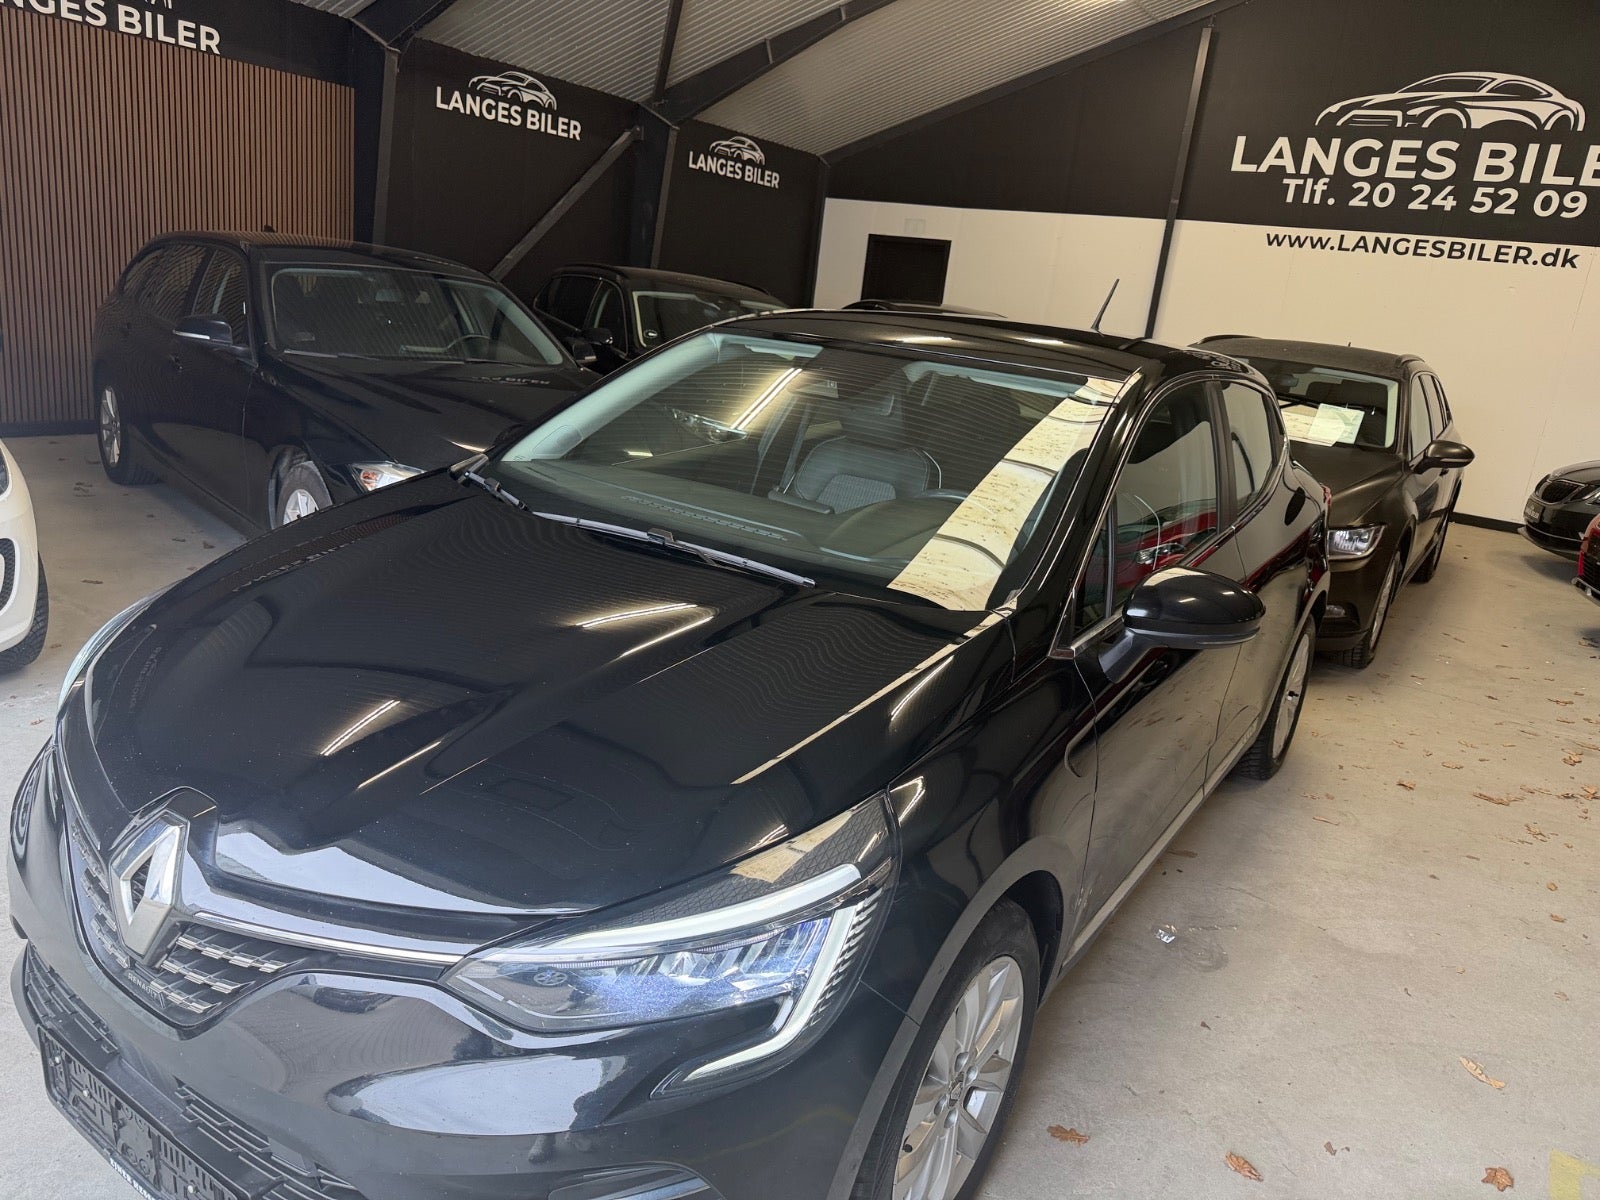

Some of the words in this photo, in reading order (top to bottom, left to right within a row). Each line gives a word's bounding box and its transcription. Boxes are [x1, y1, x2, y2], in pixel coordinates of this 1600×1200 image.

[0, 0, 107, 27] GES
[117, 3, 221, 55] BILER
[436, 86, 522, 126] LANGES
[526, 109, 582, 141] BILER
[688, 151, 743, 180] LANGES
[744, 165, 780, 189] BILER
[1230, 135, 1461, 181] LANGES
[1282, 178, 1336, 206] Tlf.
[1348, 181, 1396, 208] 20
[1407, 184, 1457, 211] 24
[1468, 187, 1519, 215] 52
[1533, 190, 1588, 218] 09
[1266, 232, 1581, 269] www.LANGESBILER.dk
[127, 972, 158, 1000] RENAULT
